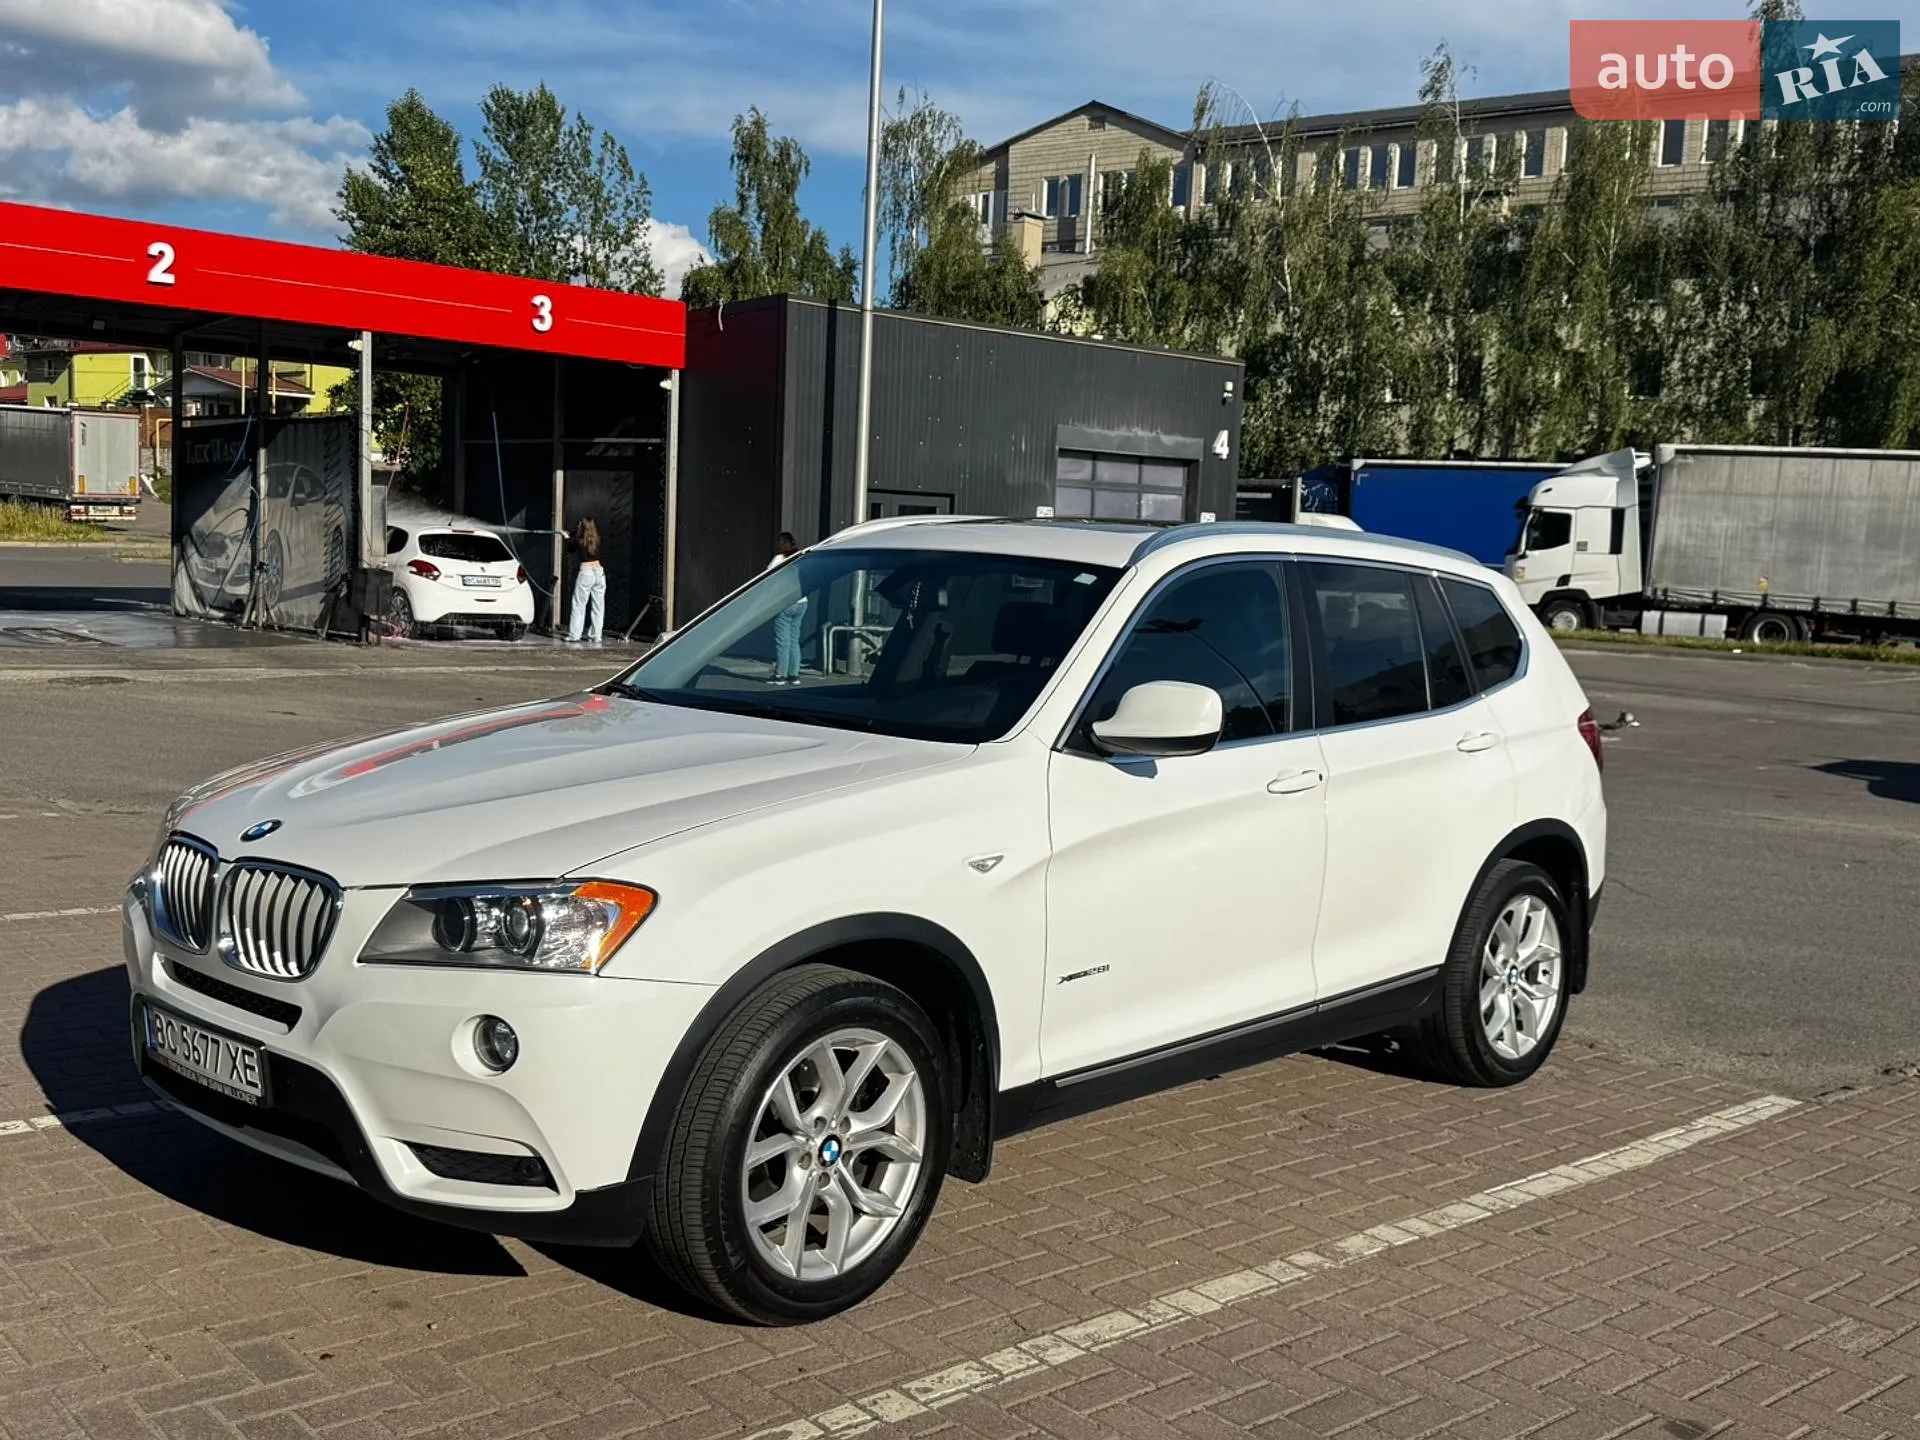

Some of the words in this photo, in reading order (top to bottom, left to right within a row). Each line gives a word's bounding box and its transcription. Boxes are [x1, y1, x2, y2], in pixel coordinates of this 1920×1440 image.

[147, 241, 176, 285] 2
[530, 294, 553, 332] 3
[1211, 429, 1230, 460] 4
[180, 1023, 222, 1075] 5677
[226, 1042, 261, 1090] XE
